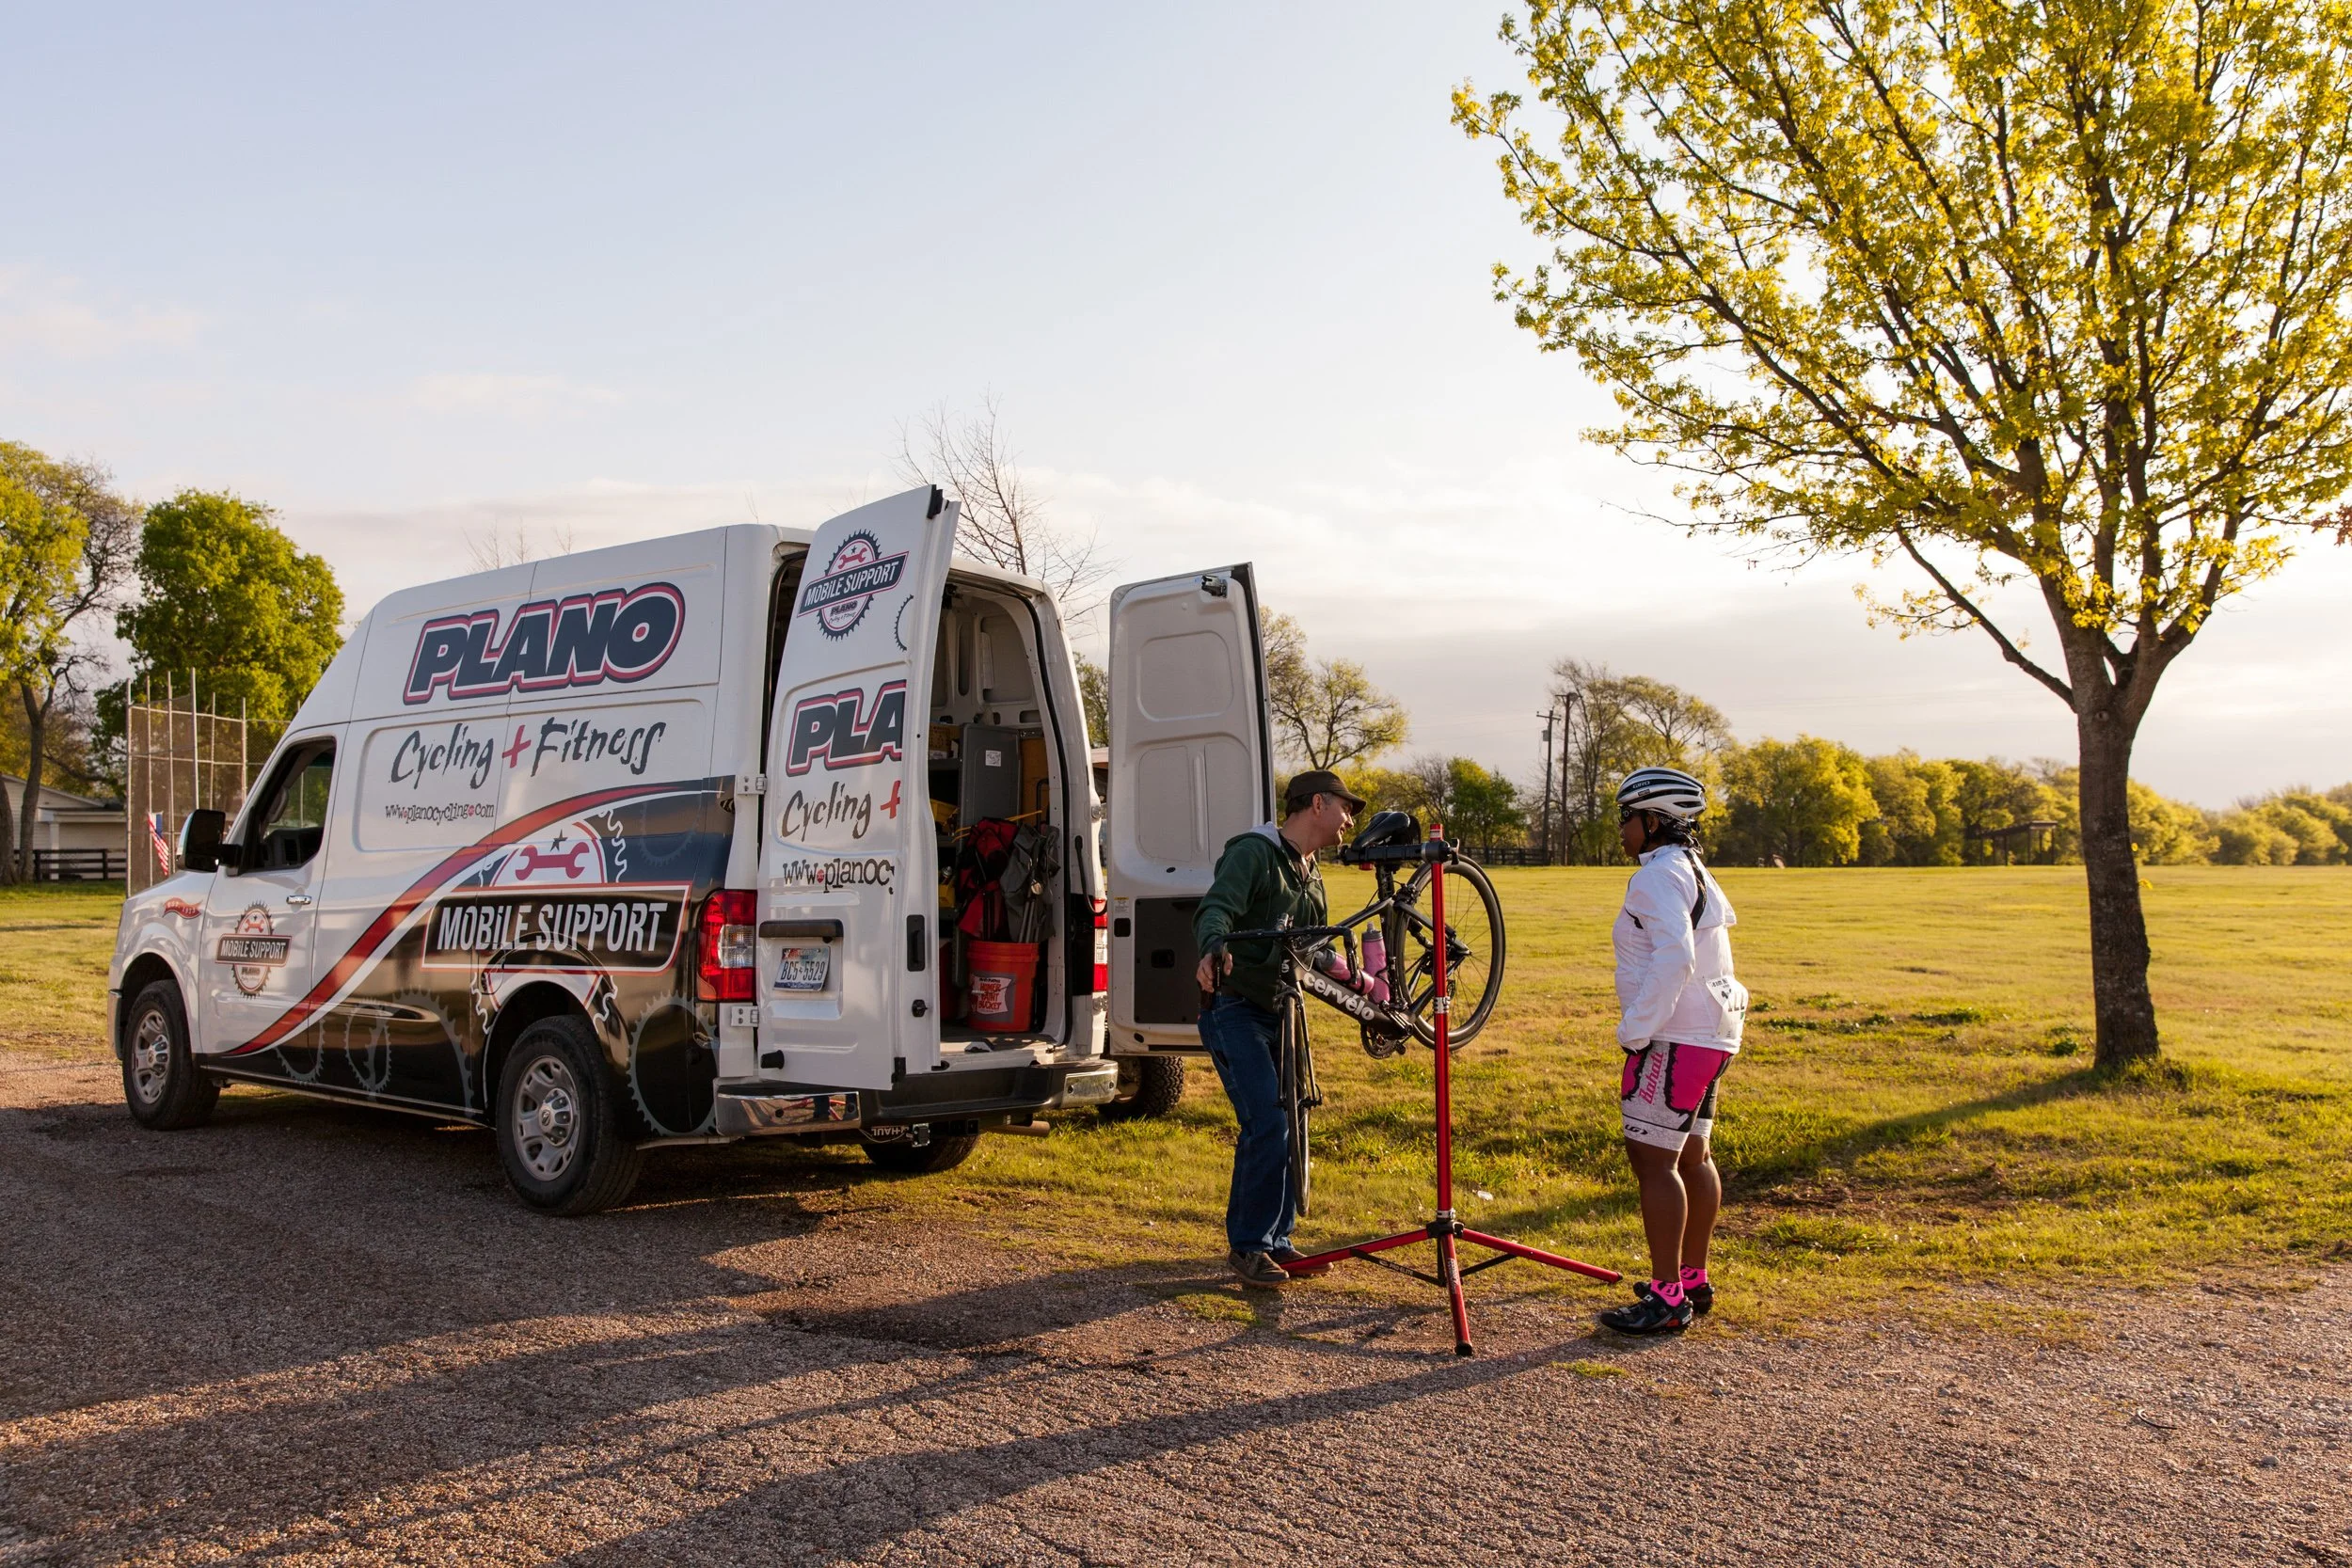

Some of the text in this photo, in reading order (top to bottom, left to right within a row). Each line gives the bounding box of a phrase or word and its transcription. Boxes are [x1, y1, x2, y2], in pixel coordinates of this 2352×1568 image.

[844, 562, 899, 594] SUPPORT
[403, 581, 686, 705] PLANO
[388, 722, 495, 790] Cycling
[531, 717, 667, 777] Fitness
[1632, 781, 1650, 789] GIRO
[781, 781, 872, 842] Cycling
[249, 942, 287, 959] SUPPORT
[534, 902, 669, 952] SUPPORT
[1303, 972, 1375, 1021] cervélo
